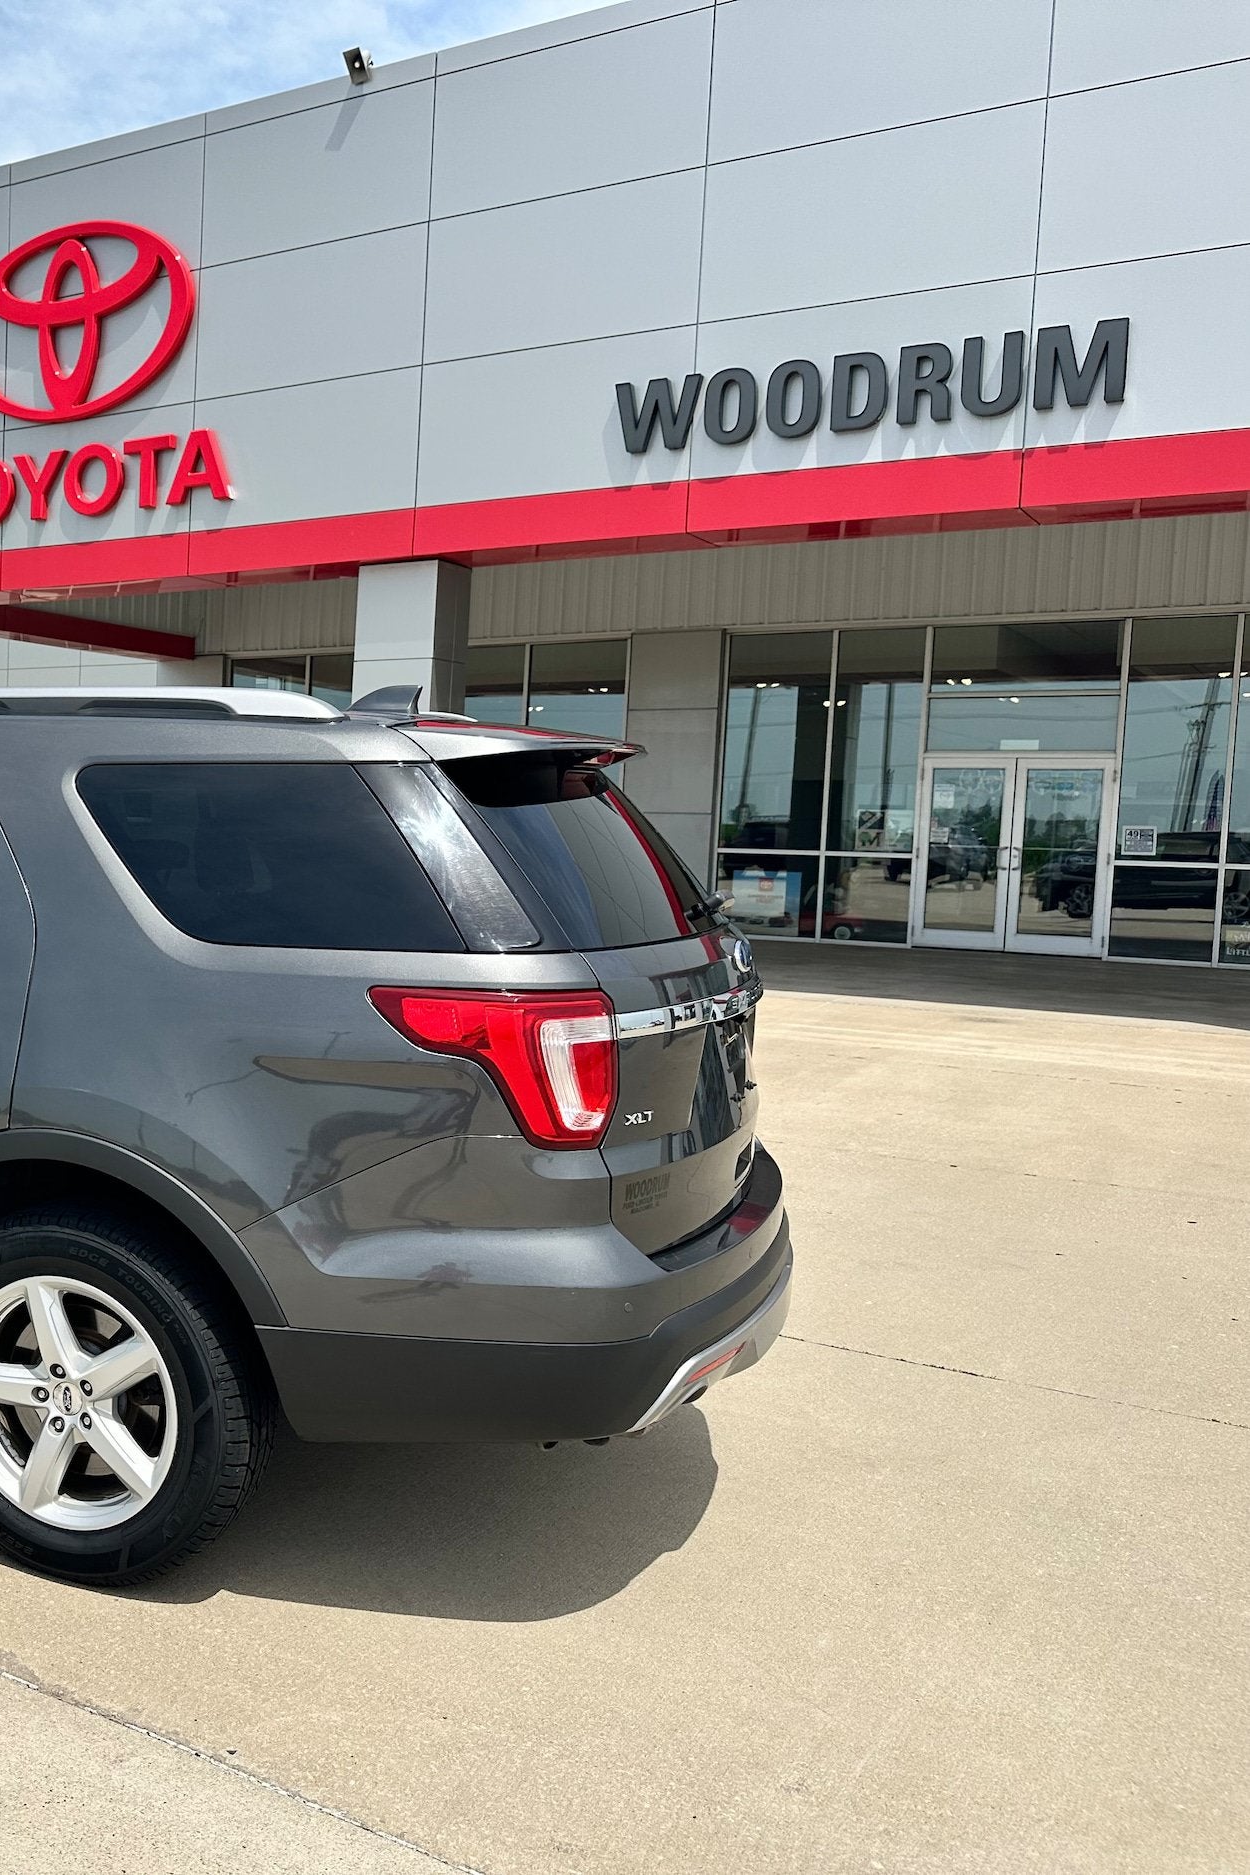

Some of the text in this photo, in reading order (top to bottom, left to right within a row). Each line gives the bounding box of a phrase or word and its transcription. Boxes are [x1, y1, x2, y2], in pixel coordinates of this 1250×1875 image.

[615, 317, 1129, 454] WOODRUM
[623, 1109, 654, 1127] XLT
[625, 1172, 671, 1202] WOODRUM
[69, 1246, 173, 1324] EDGE TOURING
